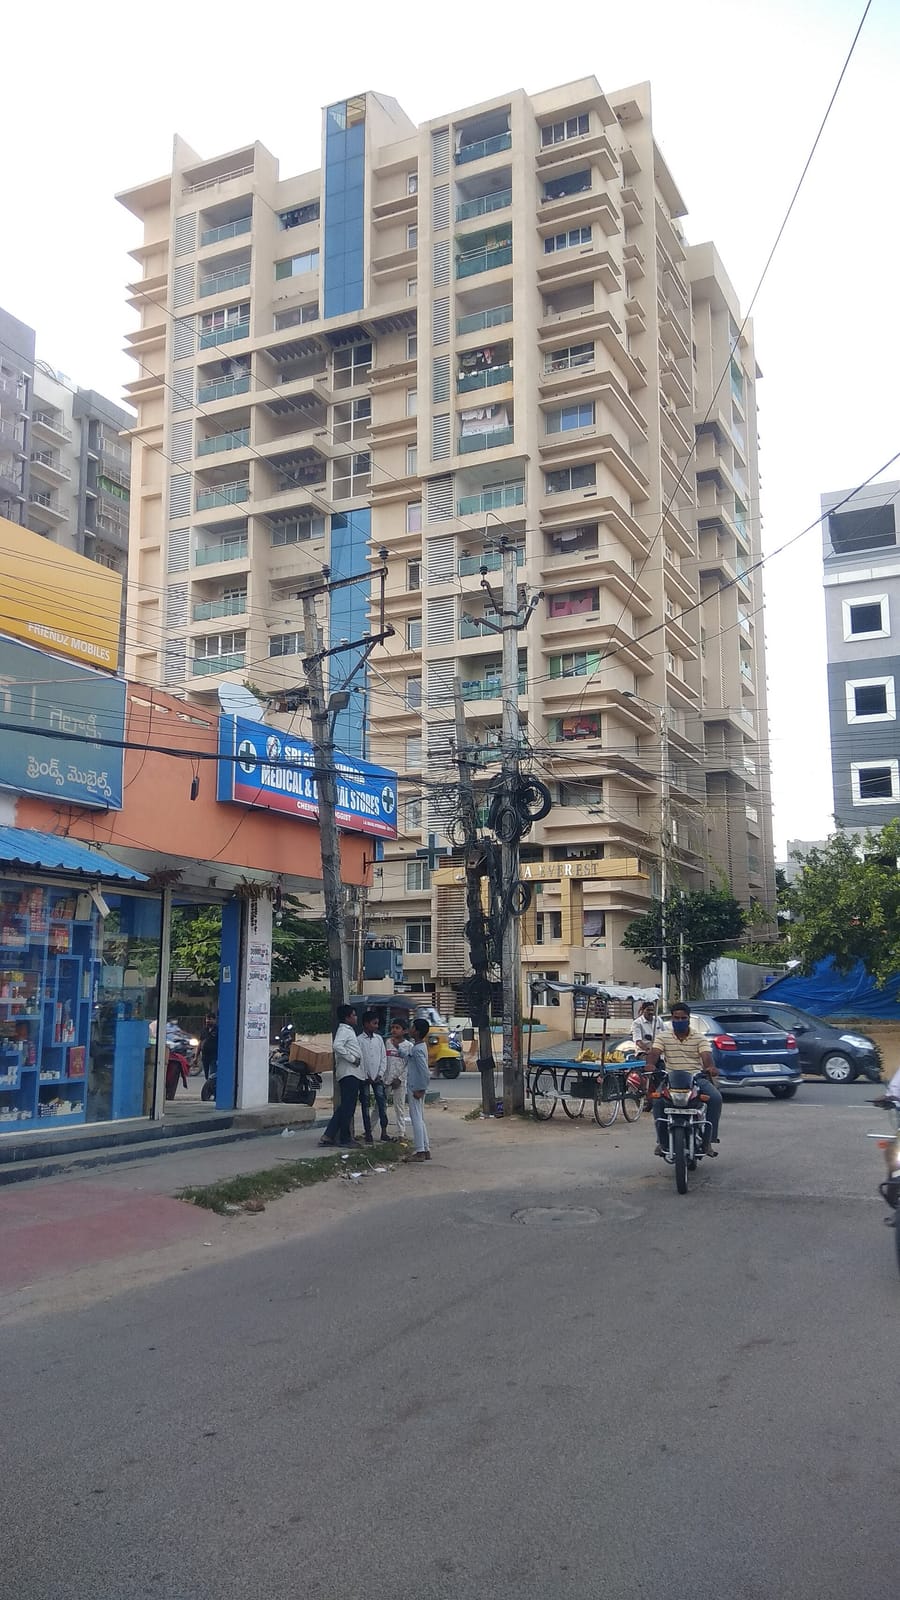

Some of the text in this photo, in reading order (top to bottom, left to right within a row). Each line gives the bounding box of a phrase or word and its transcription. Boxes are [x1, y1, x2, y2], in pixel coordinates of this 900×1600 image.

[27, 623, 110, 661] FRIENDZ MOBILES
[284, 746, 302, 766] SRI
[261, 764, 303, 795] MEDICAL
[304, 779, 312, 798] &
[350, 789, 380, 816] STORES
[540, 863, 599, 878] EVEREST
